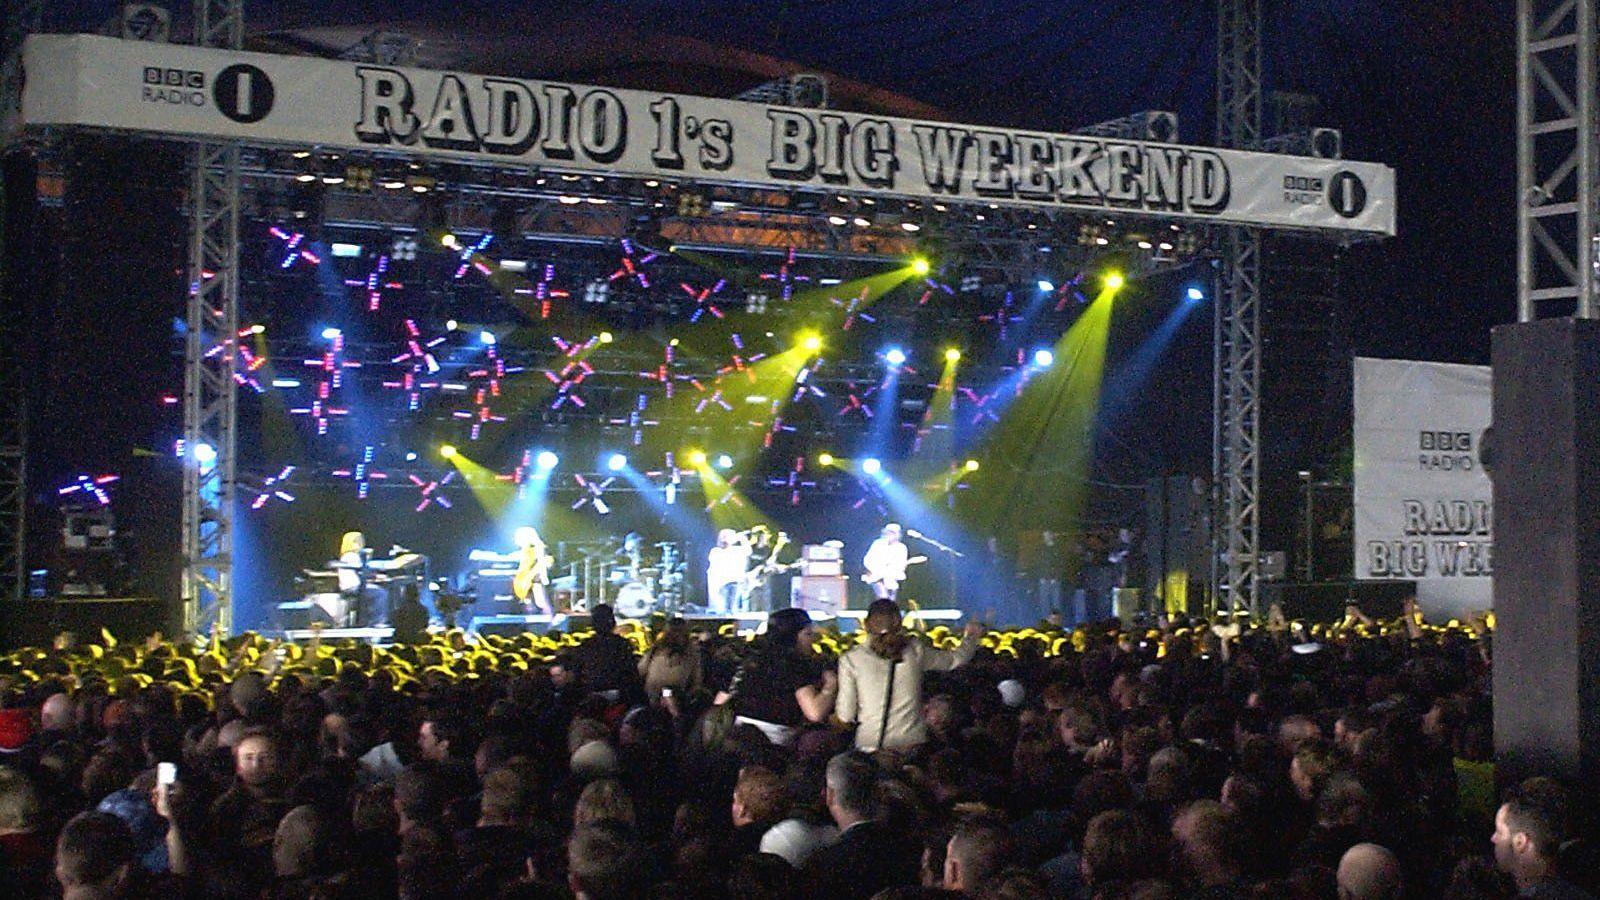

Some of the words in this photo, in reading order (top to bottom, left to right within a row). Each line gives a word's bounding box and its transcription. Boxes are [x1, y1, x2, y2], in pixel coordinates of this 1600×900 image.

[143, 67, 204, 88] BBC
[143, 87, 204, 107] RADIO
[355, 66, 628, 165] RADIO
[651, 96, 733, 171] 1's
[766, 105, 899, 188] BIG
[911, 123, 1231, 216] WEEKEND
[1421, 431, 1470, 450] BBC
[1420, 454, 1473, 471] RADIO
[1404, 499, 1491, 536] RADI
[1367, 540, 1428, 577] BIG
[1434, 540, 1494, 577] WEE
